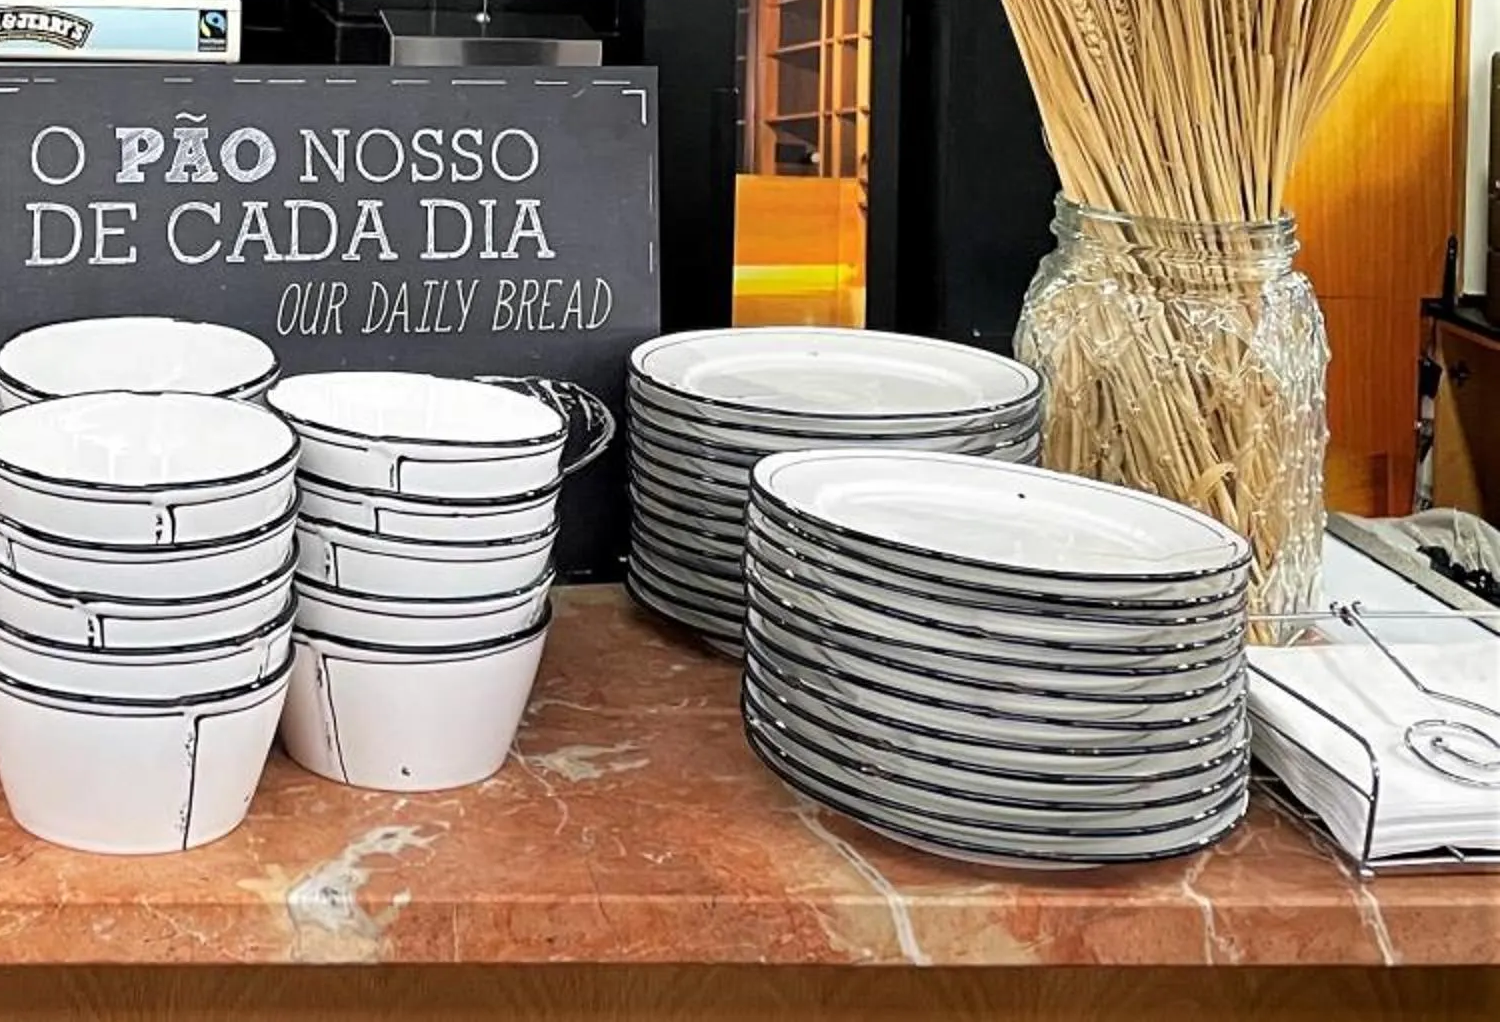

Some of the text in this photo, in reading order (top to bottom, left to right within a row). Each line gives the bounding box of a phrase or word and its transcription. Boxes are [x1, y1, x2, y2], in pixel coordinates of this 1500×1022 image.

[31, 112, 540, 185] O PÃO NOSSO
[24, 197, 556, 267] DE CADA DIA
[276, 277, 614, 336] OUR DAILY BREAD
